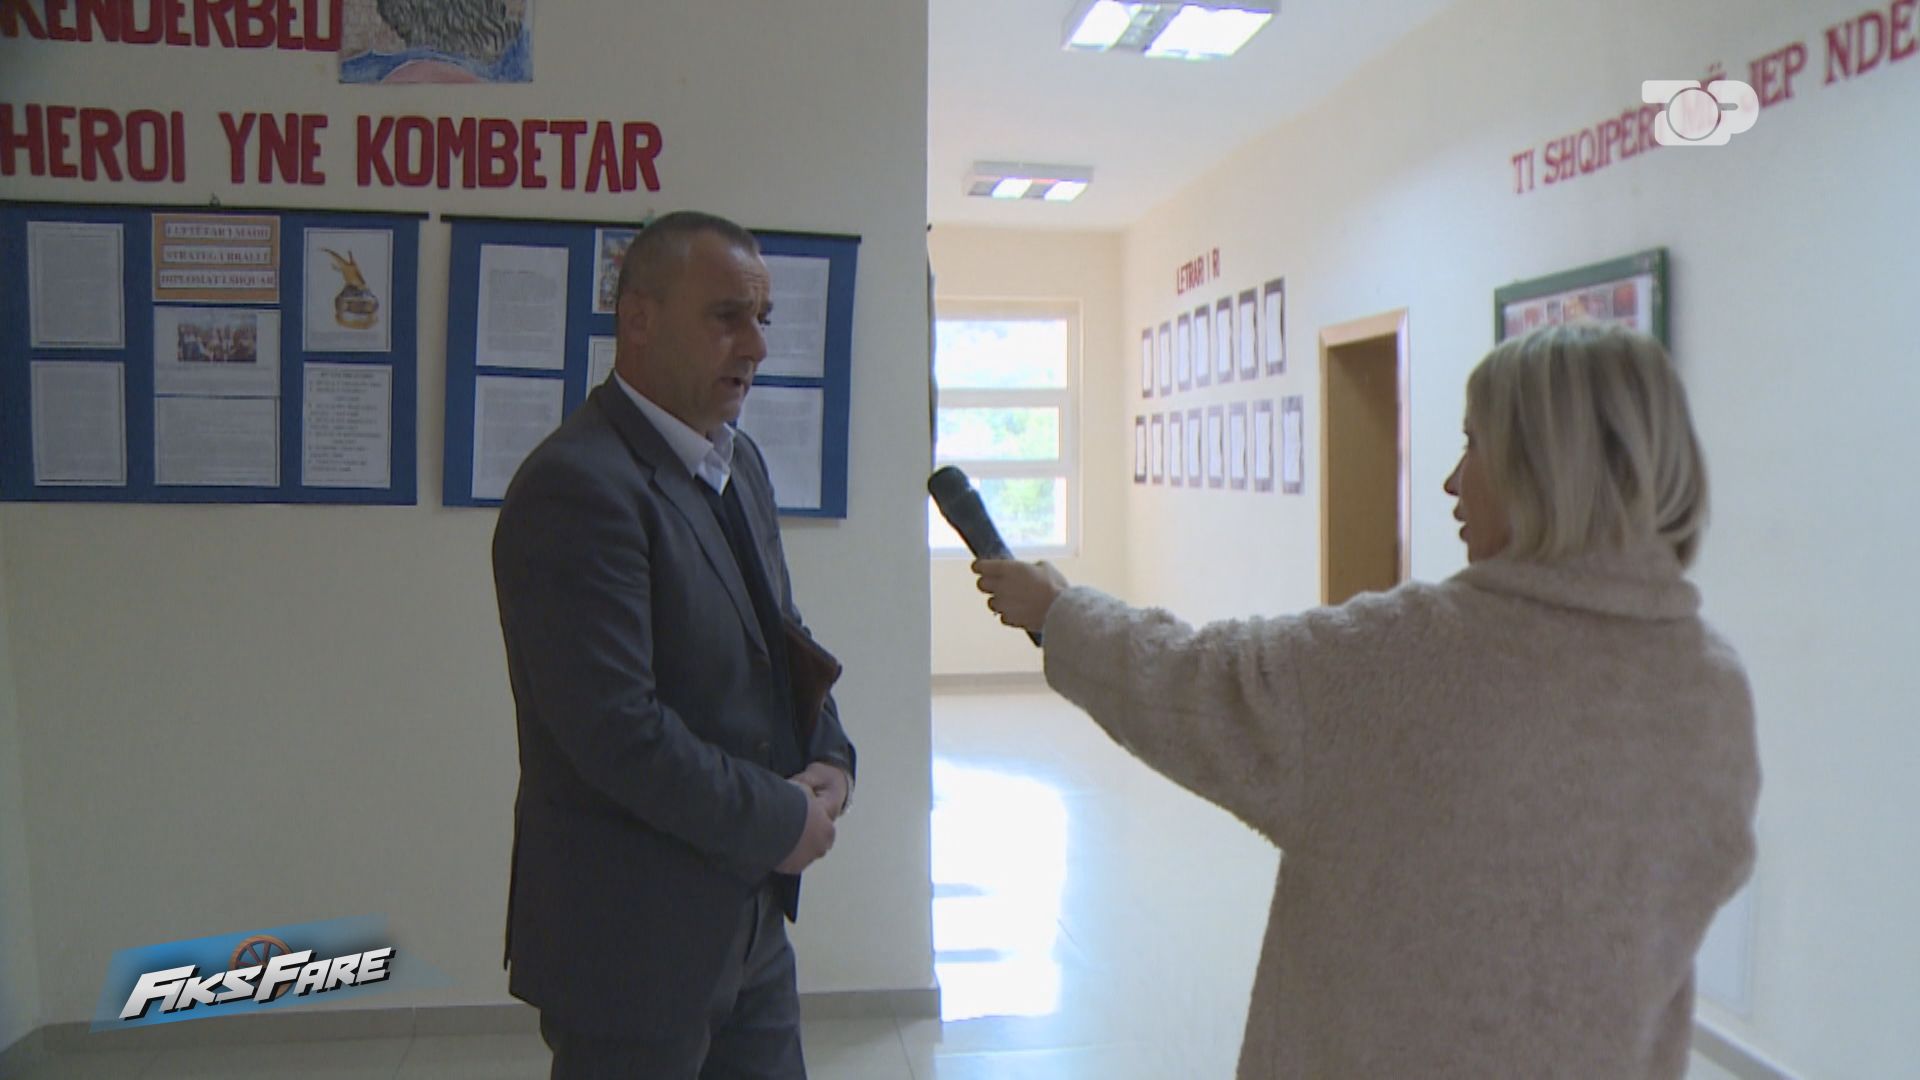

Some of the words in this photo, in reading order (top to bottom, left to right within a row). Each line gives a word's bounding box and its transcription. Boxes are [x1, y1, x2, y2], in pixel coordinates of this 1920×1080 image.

[0, 102, 185, 183] HEROI
[218, 112, 328, 185] YNE
[356, 115, 663, 193] KOMBETAR
[1510, 148, 1535, 195] TI
